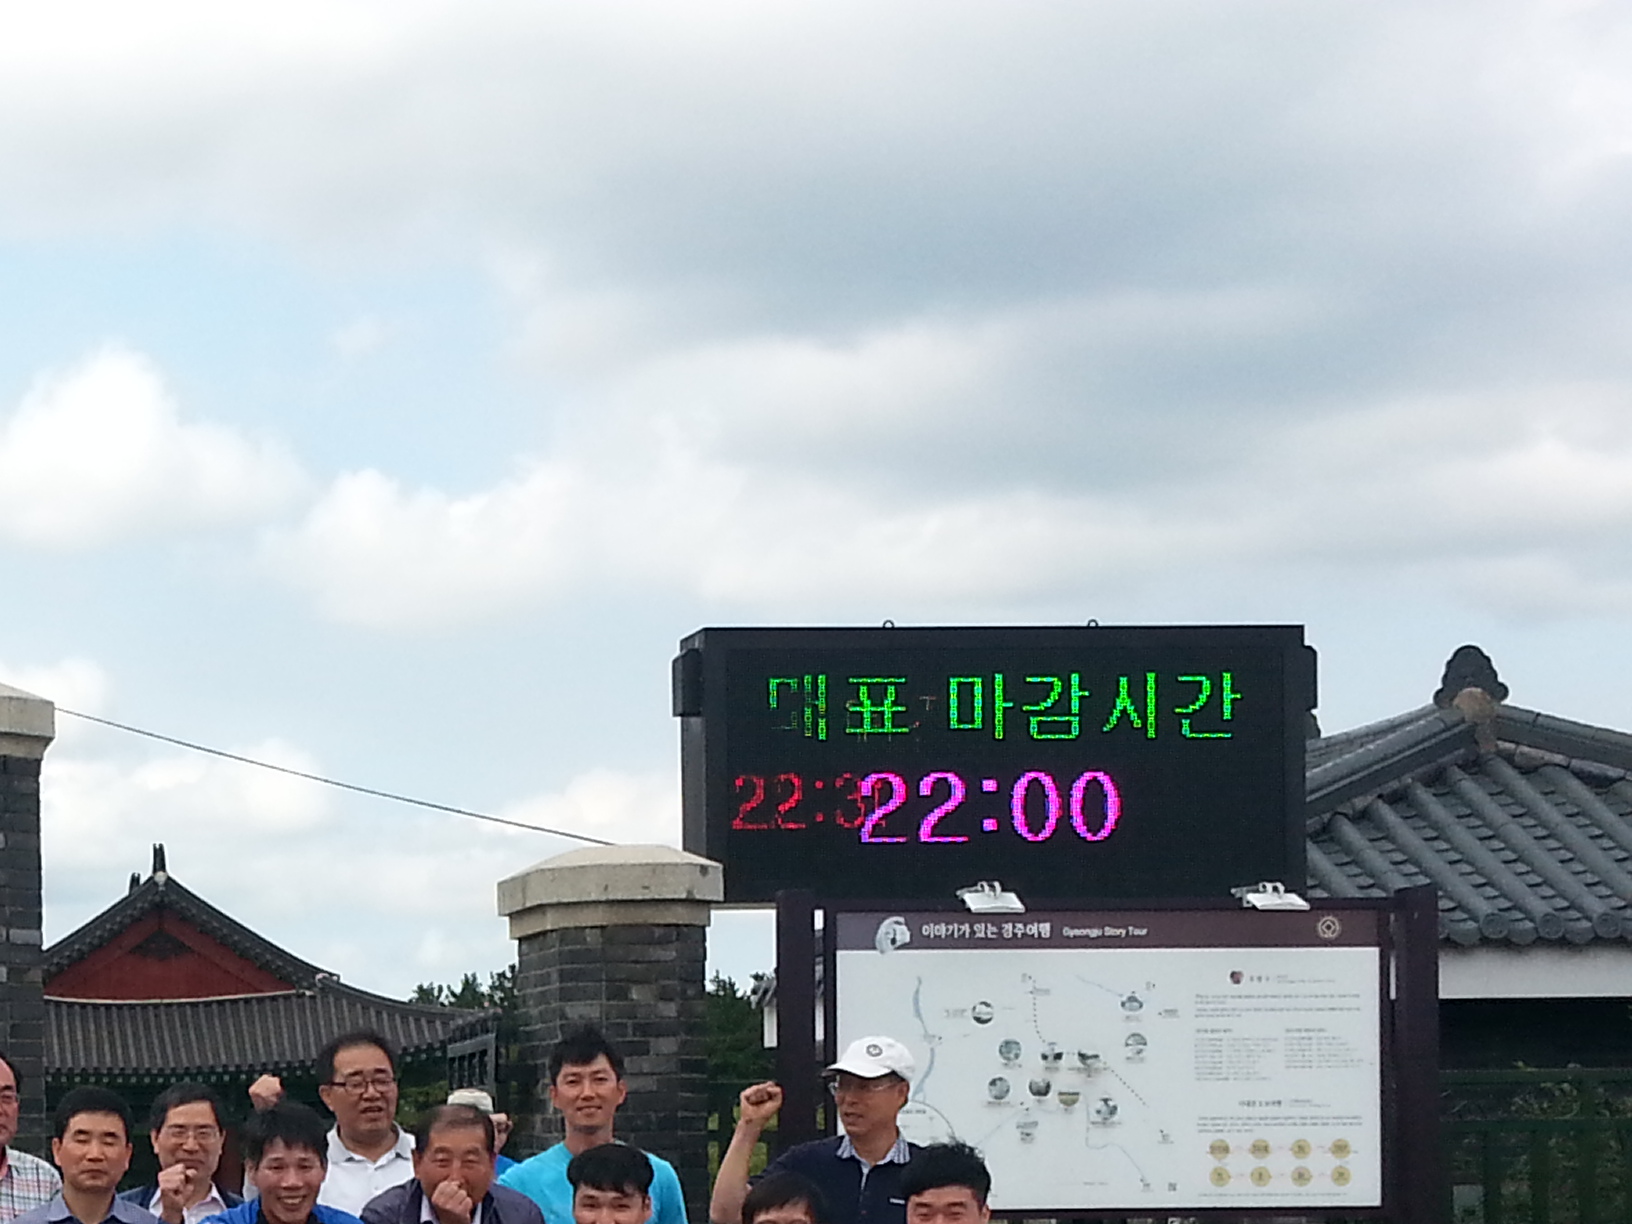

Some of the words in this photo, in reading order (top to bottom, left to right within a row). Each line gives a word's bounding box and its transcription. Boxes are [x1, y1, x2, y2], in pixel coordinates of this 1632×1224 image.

[949, 671, 1243, 741] 마감시간
[860, 769, 1124, 843] 22:00
[921, 922, 970, 939] 이야기가
[973, 922, 999, 939] 있는
[1001, 922, 1051, 939] 경주여행
[1104, 925, 1126, 938] Story
[1128, 925, 1148, 936] Tour
